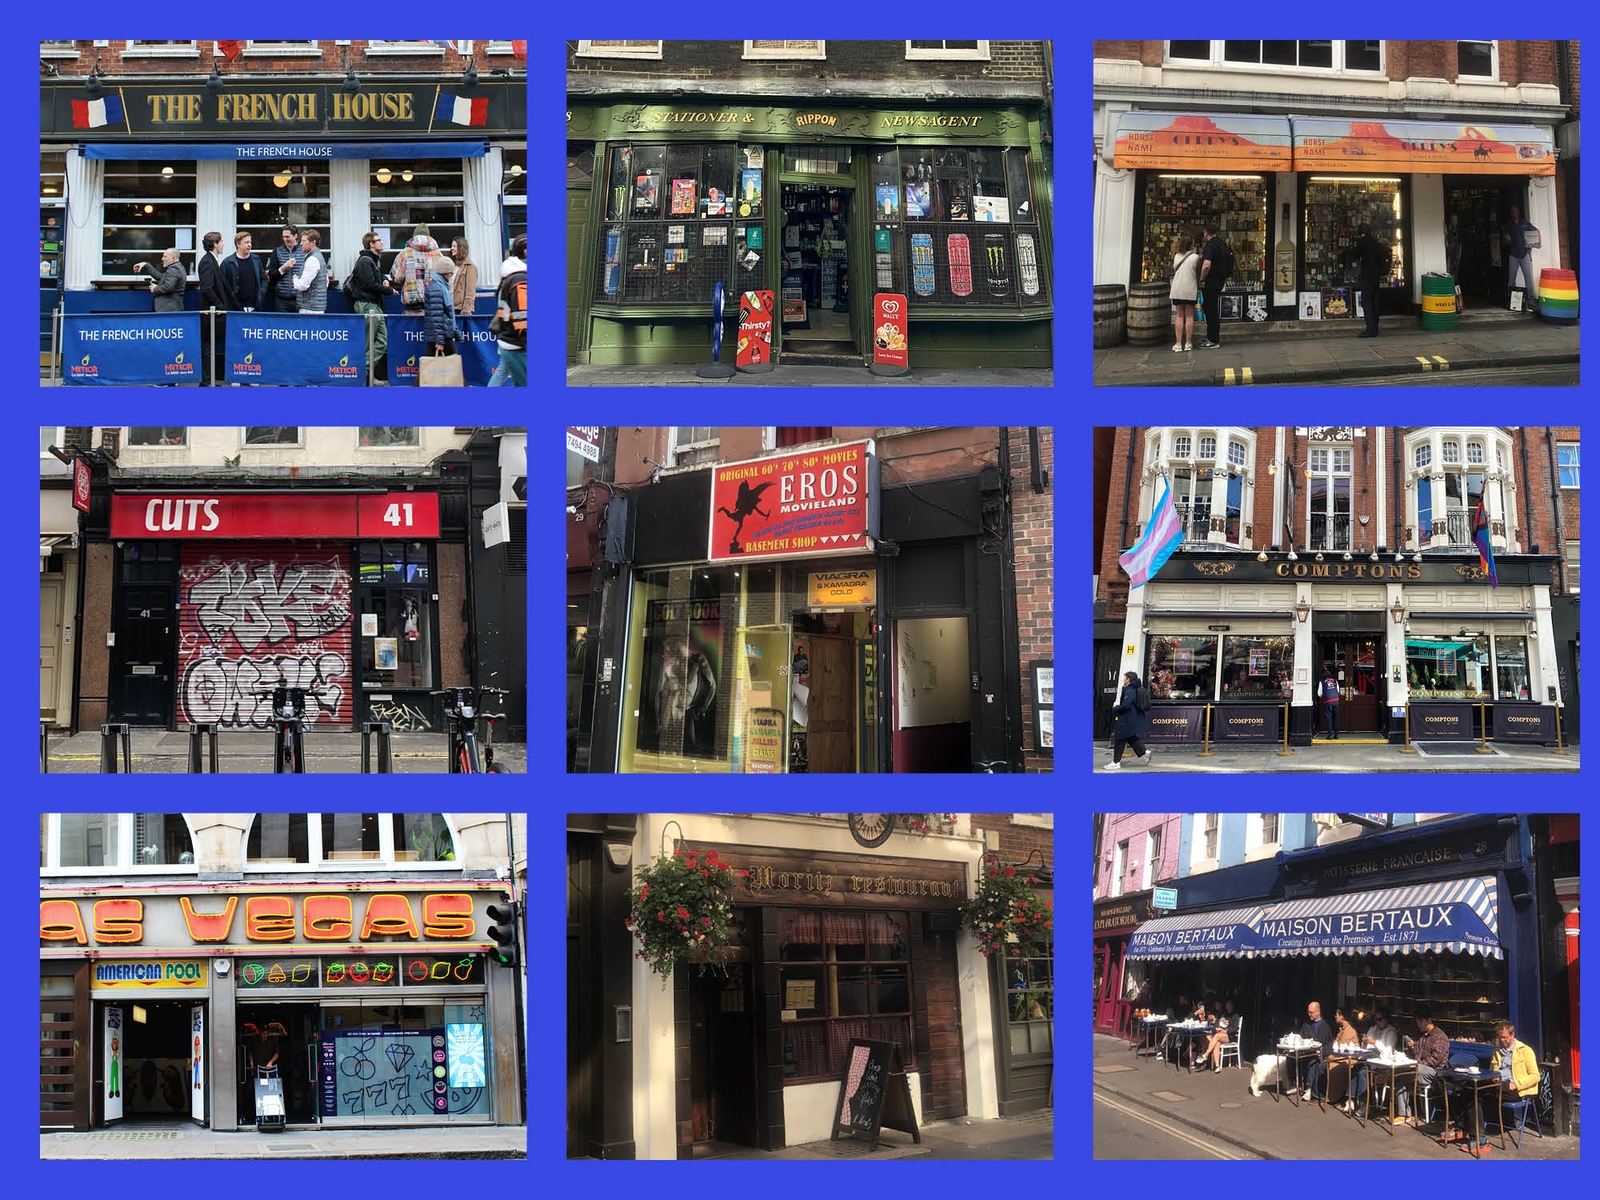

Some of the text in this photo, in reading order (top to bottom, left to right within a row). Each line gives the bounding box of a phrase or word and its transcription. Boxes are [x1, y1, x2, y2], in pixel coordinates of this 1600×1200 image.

[147, 92, 414, 123] THE FRENCH HOUSE
[653, 111, 982, 128] STATIONER & RIPPON NEWSAGENT
[1128, 132, 1155, 142] HORSE
[1303, 138, 1326, 147] HORSE
[236, 146, 332, 157] THE FRENCH HOUSE
[1128, 143, 1155, 153] NAME
[1303, 147, 1326, 156] NAME
[741, 320, 771, 331] Thirsty?
[79, 328, 184, 341] THE FRENCH HOUSE
[242, 328, 348, 342] THE FRENCH HOUSE
[404, 331, 425, 342] THE
[71, 365, 98, 373] METEOR
[165, 363, 193, 371] METEOR
[233, 363, 261, 372] METEOR
[328, 366, 357, 375] METEOR
[567, 436, 582, 450] 7494
[720, 468, 759, 482] ORIGINAL
[761, 463, 779, 475] 60's
[782, 458, 800, 473] 70's
[822, 449, 858, 466] MOVIES
[780, 465, 859, 504] EROS
[780, 497, 857, 514] MOVIELAND
[145, 498, 220, 533] CUTS
[383, 503, 413, 526] 41
[575, 513, 584, 522] 29
[746, 536, 818, 553] BASEMENT SHOP
[815, 571, 870, 580] VIAGRA
[1276, 562, 1422, 580] COMPTONS
[824, 580, 867, 589] KAMAGRA
[140, 609, 152, 619] 41
[1127, 645, 1135, 654] H
[1410, 690, 1465, 698] COMPTONS
[753, 718, 778, 728] VIAGRA
[1475, 841, 1487, 853] 28
[750, 865, 960, 898] Moritz restaurant
[180, 893, 476, 943] VEGAS
[1262, 906, 1454, 937] MAISON BERTAUX
[1132, 925, 1238, 946] MAISON BERTAUX
[1278, 938, 1303, 948] Creating
[1304, 937, 1320, 947] Daily
[1331, 936, 1341, 945] the
[1343, 934, 1375, 945] Premises
[96, 963, 202, 980] AMERICAN POOL
